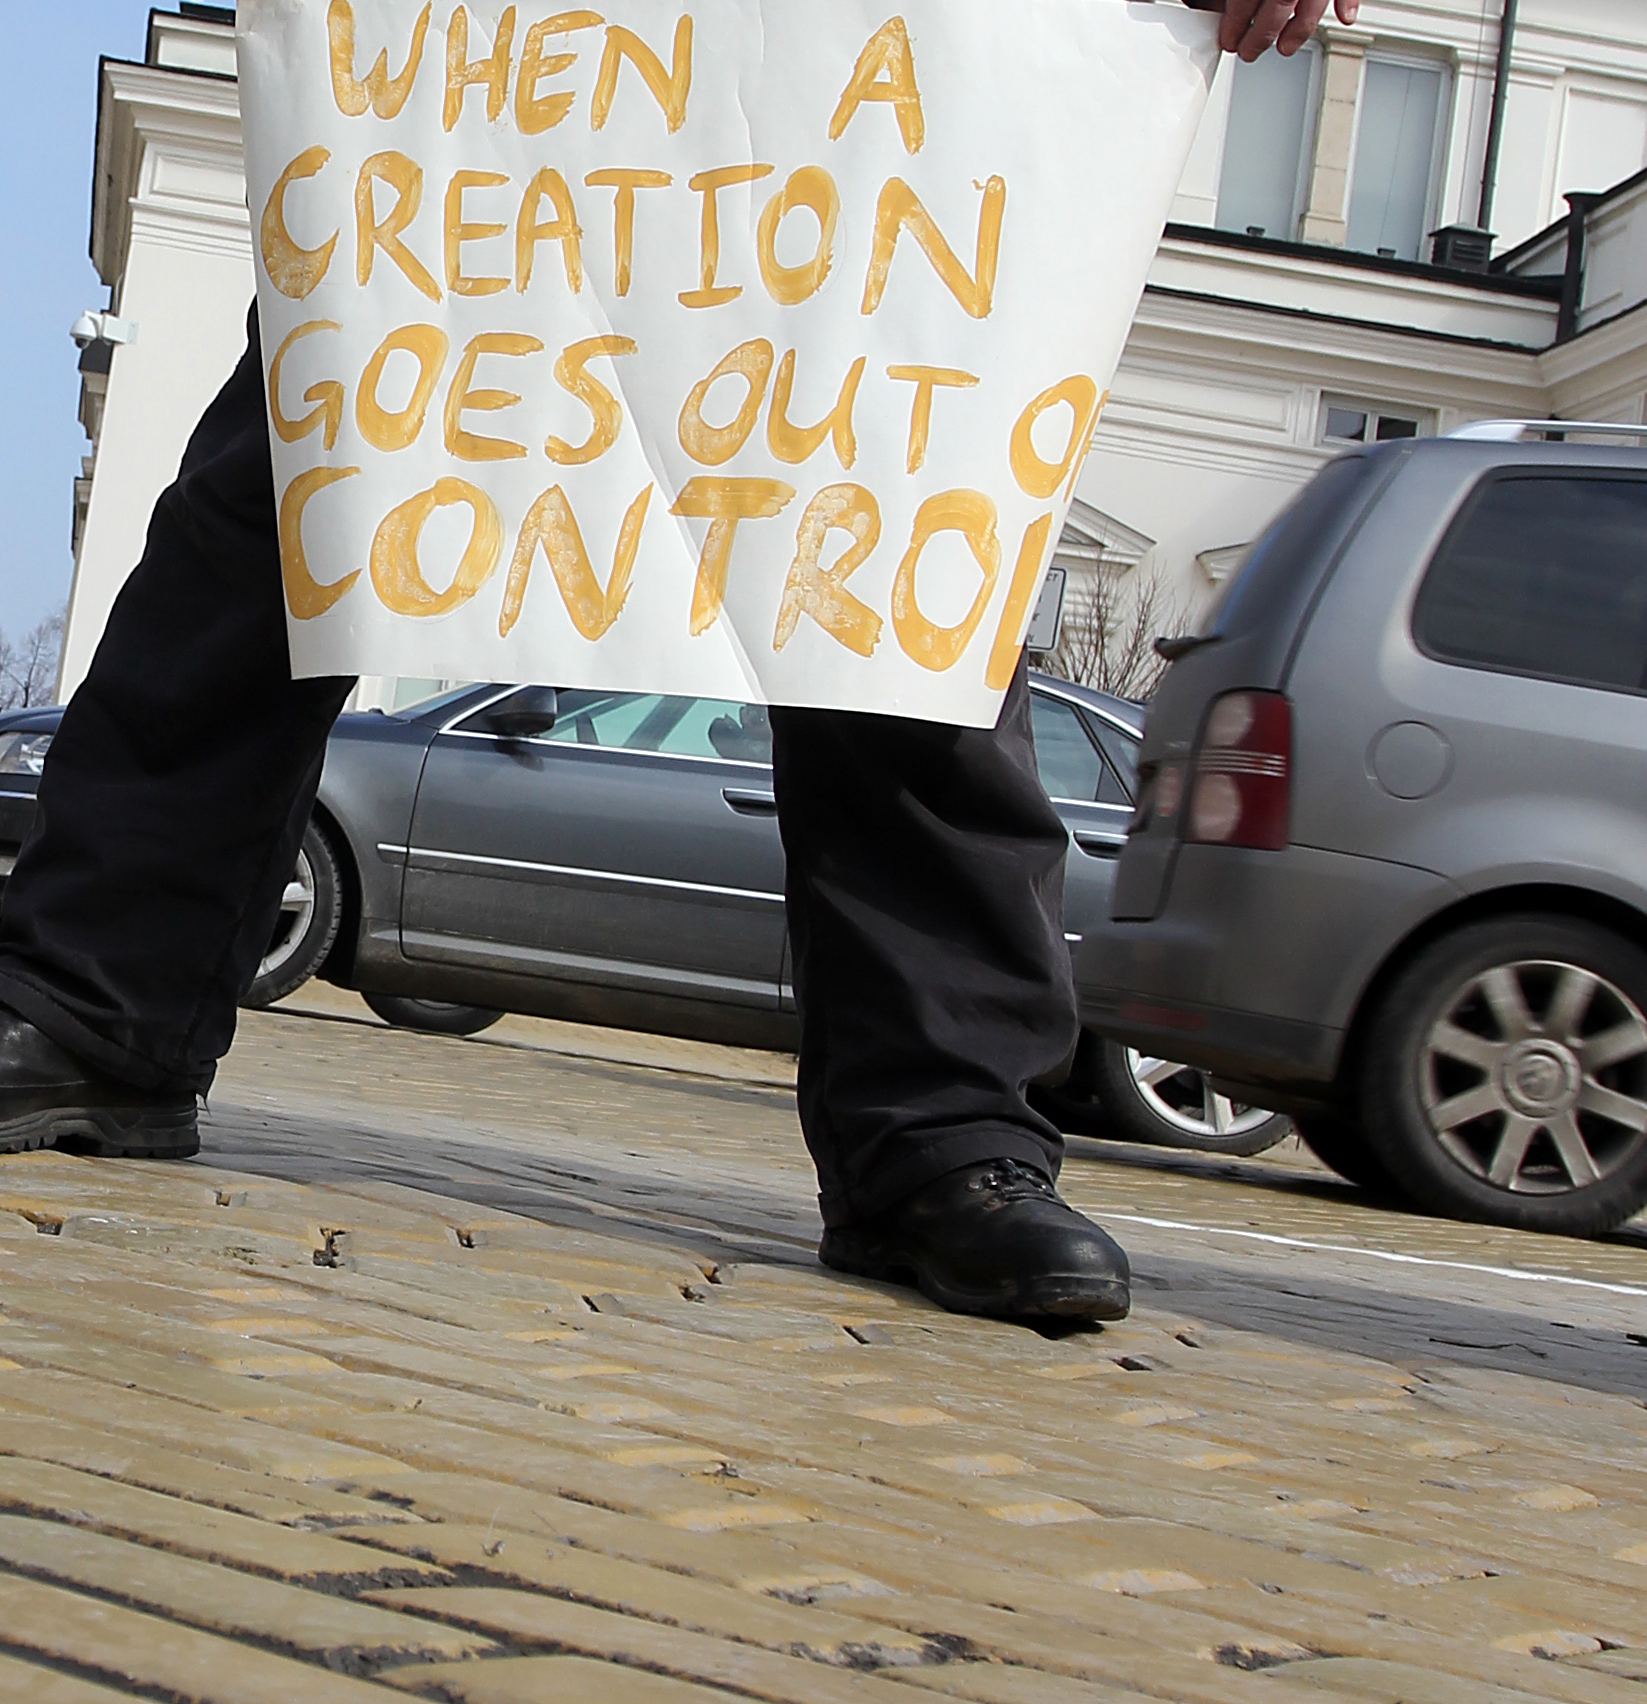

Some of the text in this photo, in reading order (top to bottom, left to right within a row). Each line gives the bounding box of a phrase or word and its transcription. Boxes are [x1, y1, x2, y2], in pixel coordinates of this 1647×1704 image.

[829, 16, 925, 154] A
[261, 145, 1006, 319] CREATION
[269, 320, 637, 466] GOES
[679, 337, 979, 474] OUT
